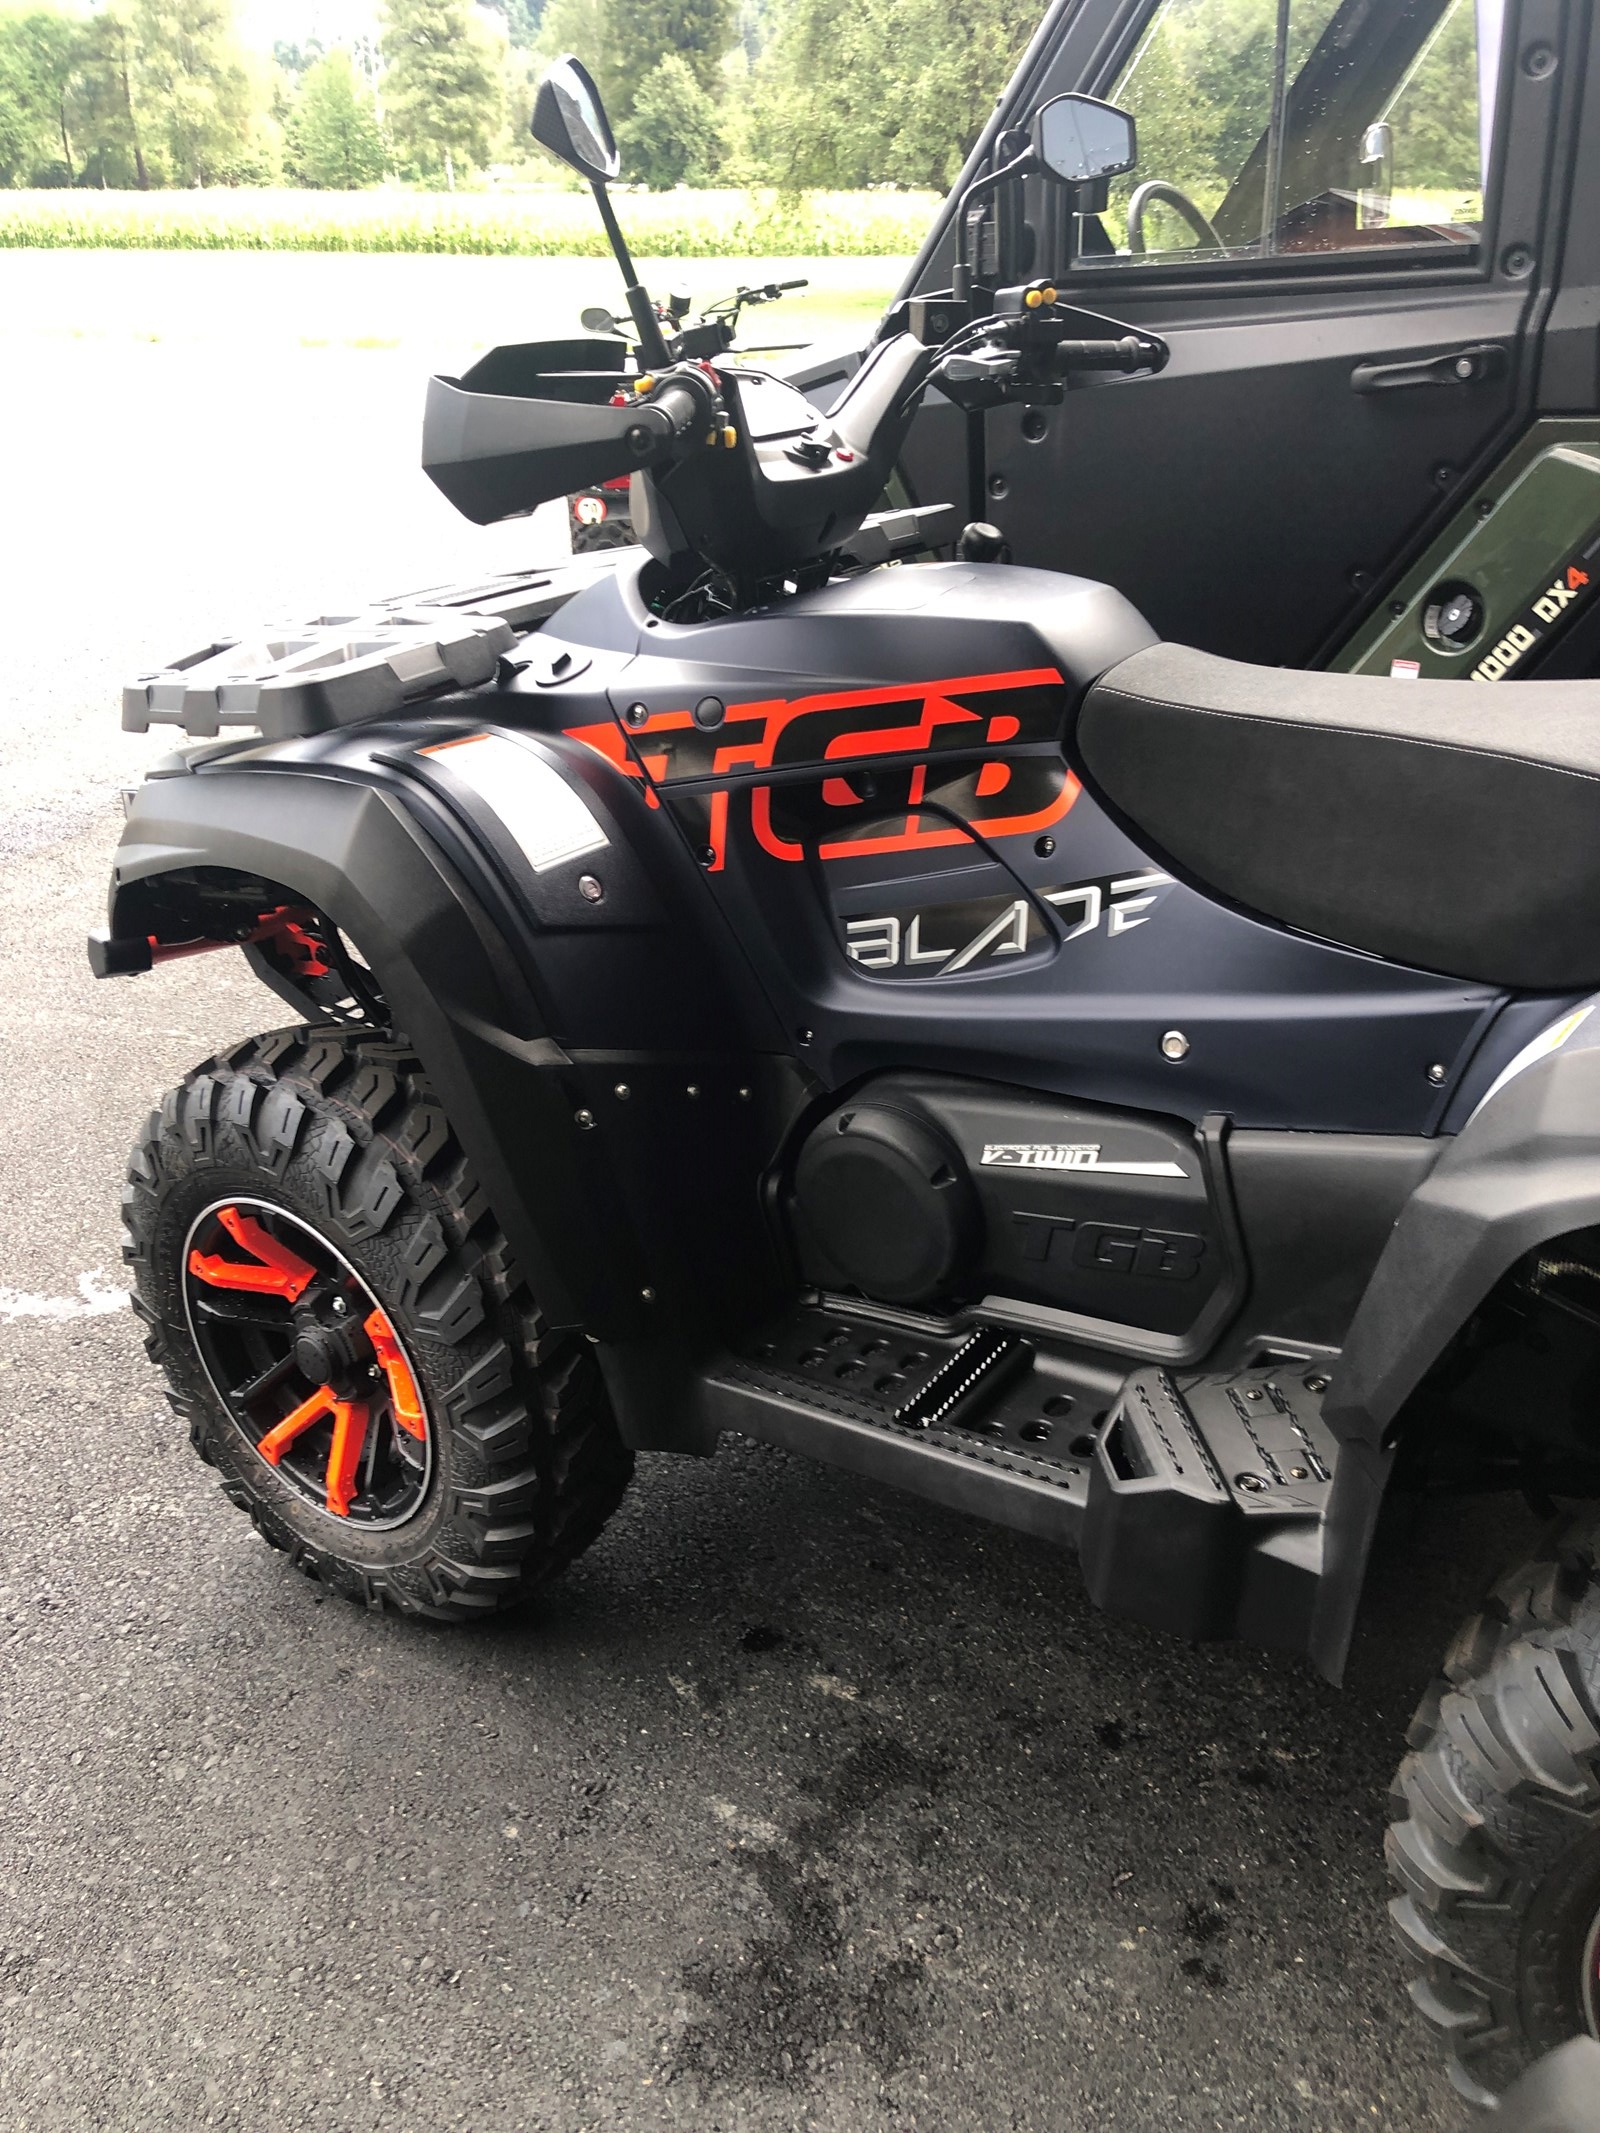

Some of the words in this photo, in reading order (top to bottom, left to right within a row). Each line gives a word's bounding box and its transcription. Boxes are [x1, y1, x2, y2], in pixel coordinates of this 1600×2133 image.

[1531, 566, 1590, 623] DX4
[562, 667, 1083, 872] TGB
[847, 873, 1177, 976] BLADE
[1012, 1210, 1206, 1281] TGB
